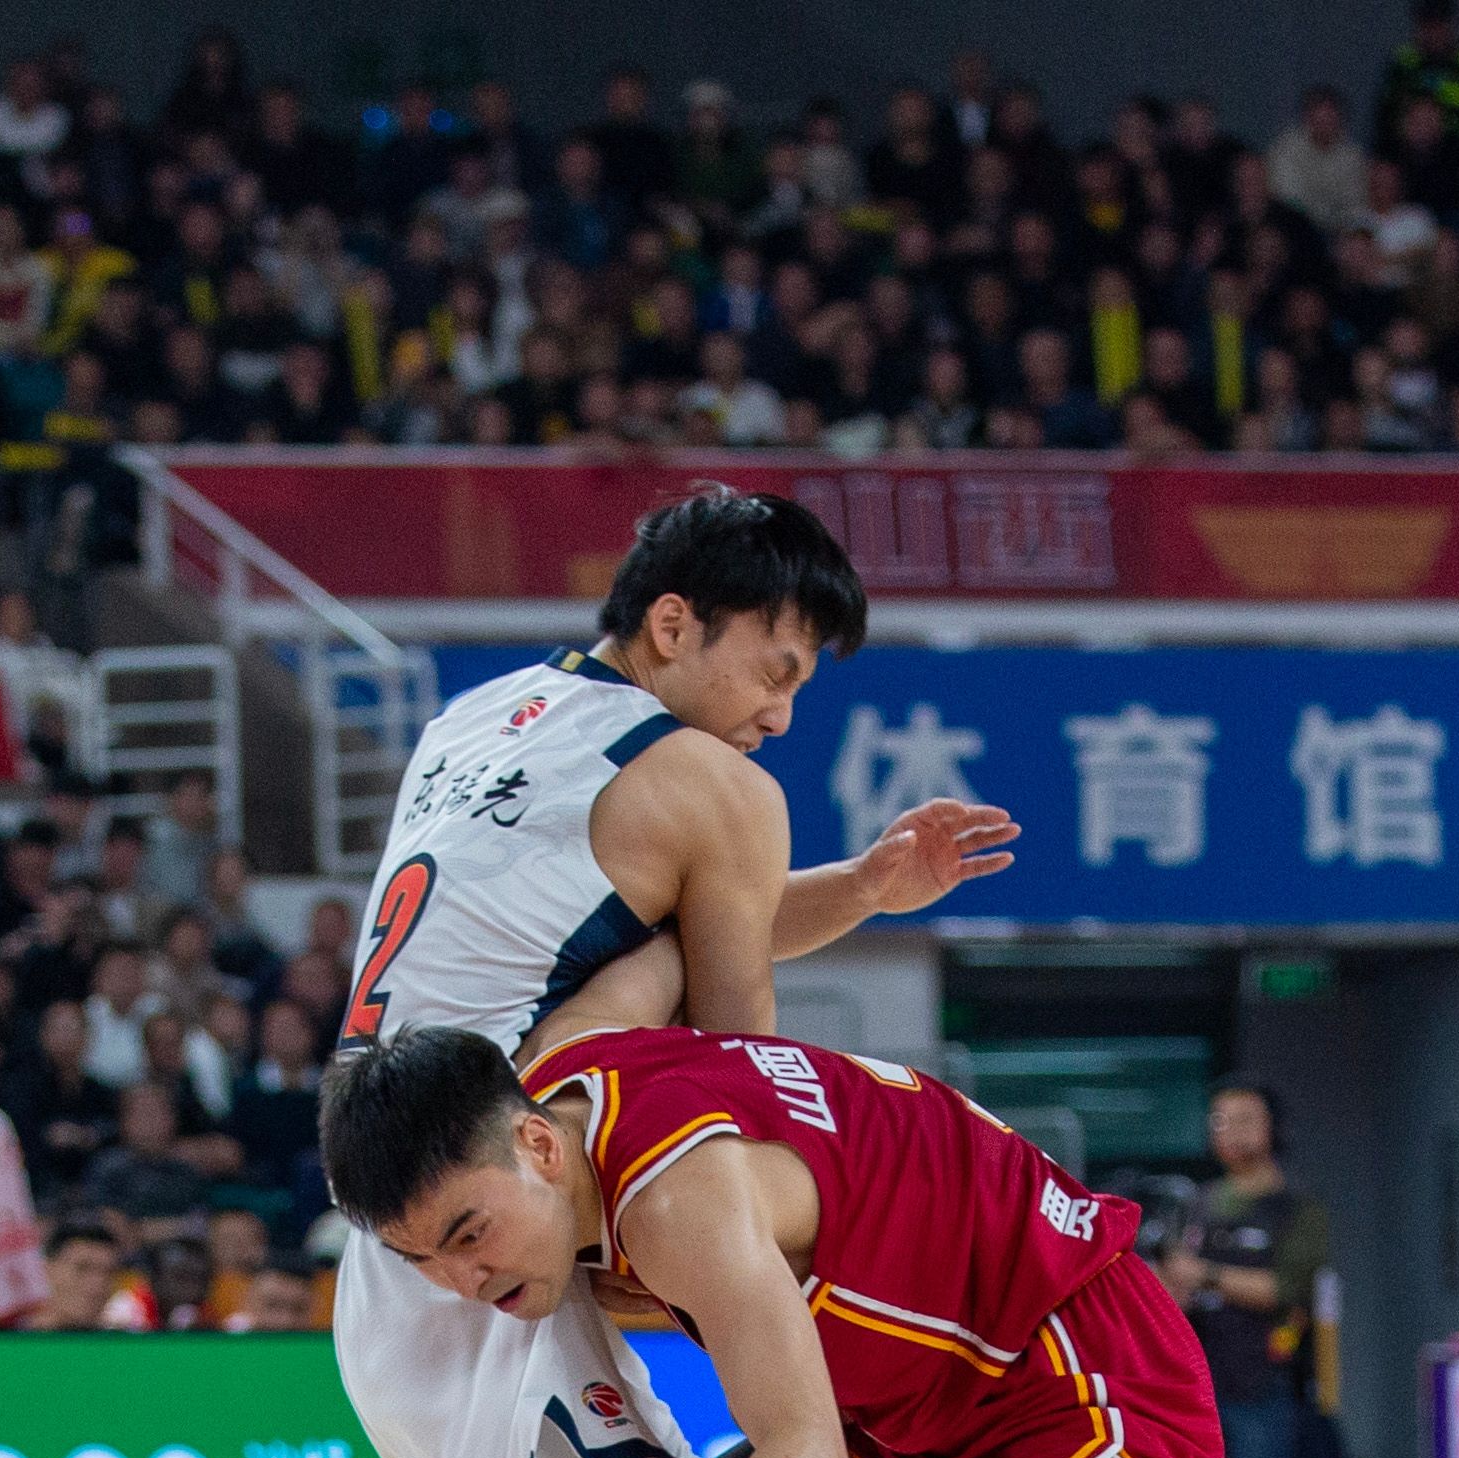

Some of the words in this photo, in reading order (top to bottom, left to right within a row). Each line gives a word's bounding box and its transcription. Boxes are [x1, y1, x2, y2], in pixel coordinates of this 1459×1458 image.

[828, 701, 1449, 869] 体育馆
[339, 852, 438, 1050] 2
[719, 1038, 838, 1133] 山西
